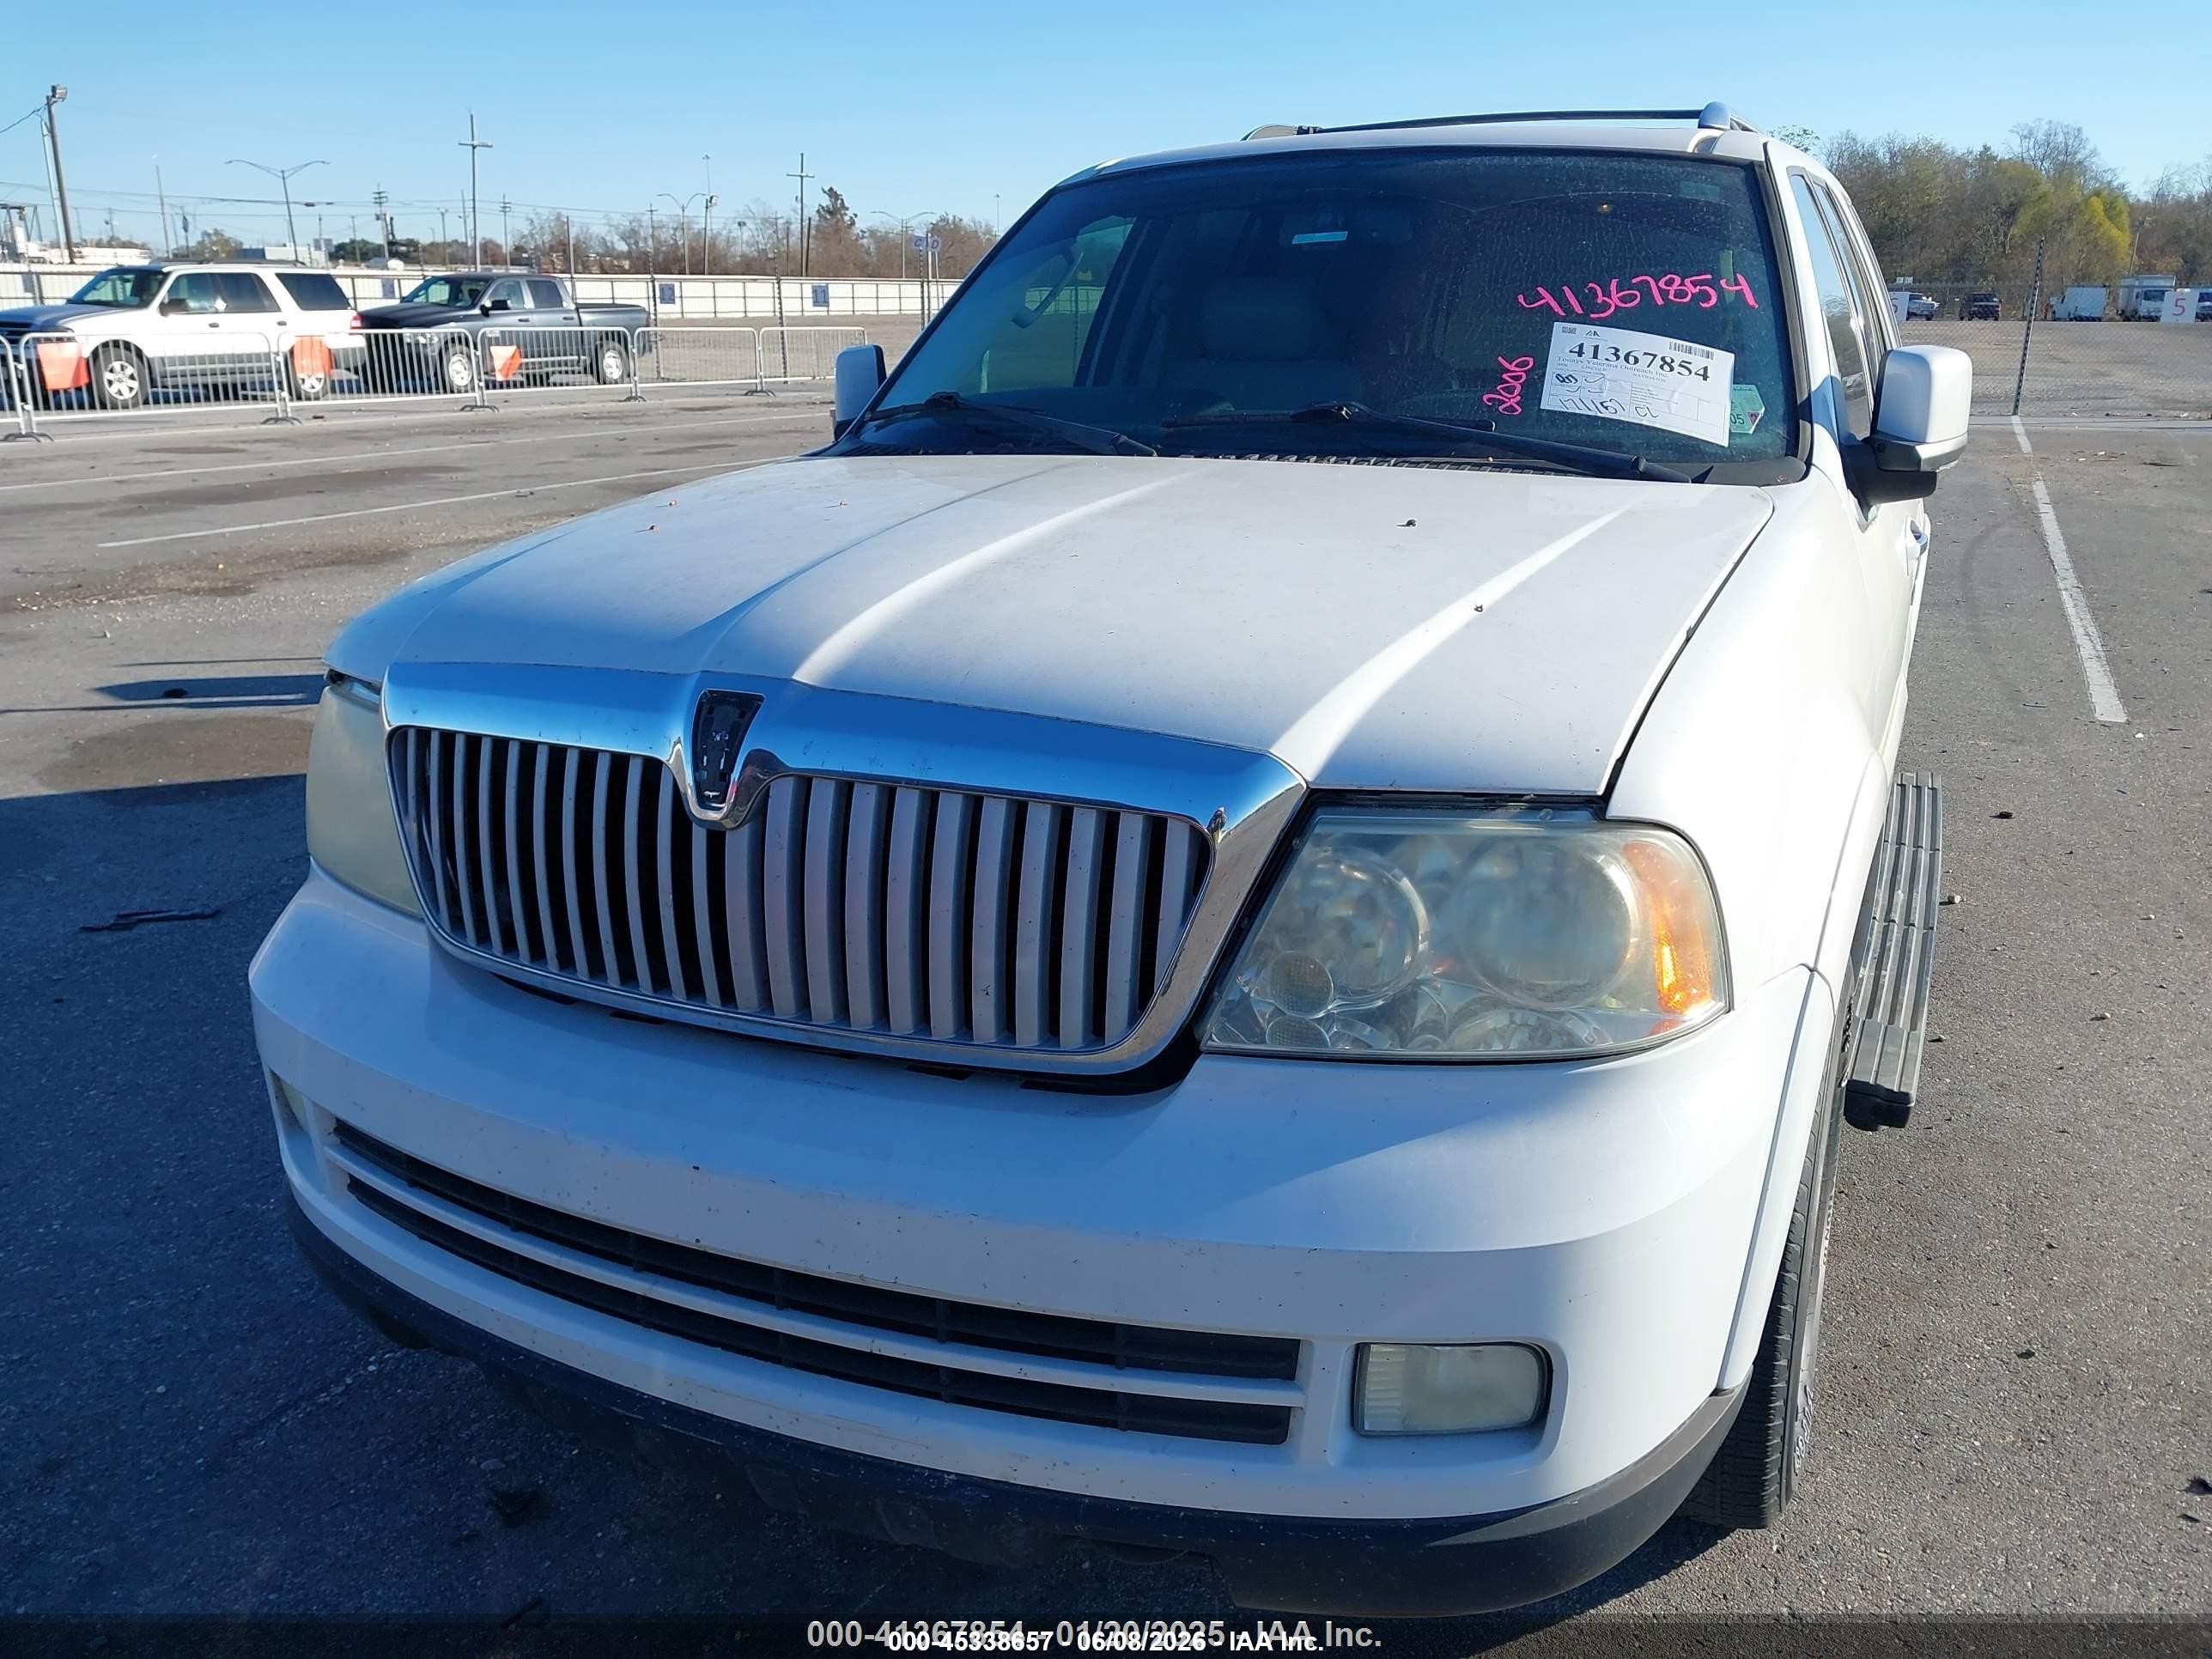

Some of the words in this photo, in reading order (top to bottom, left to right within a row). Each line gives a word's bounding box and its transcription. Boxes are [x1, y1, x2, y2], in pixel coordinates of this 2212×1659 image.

[932, 240, 939, 249] D
[1517, 273, 1759, 318] 41367854
[2172, 298, 2186, 316] 5
[1568, 342, 1711, 381] 41367854
[1586, 359, 1619, 369] Veterans
[1620, 365, 1654, 375] Outreach
[1483, 356, 1534, 415] 2006
